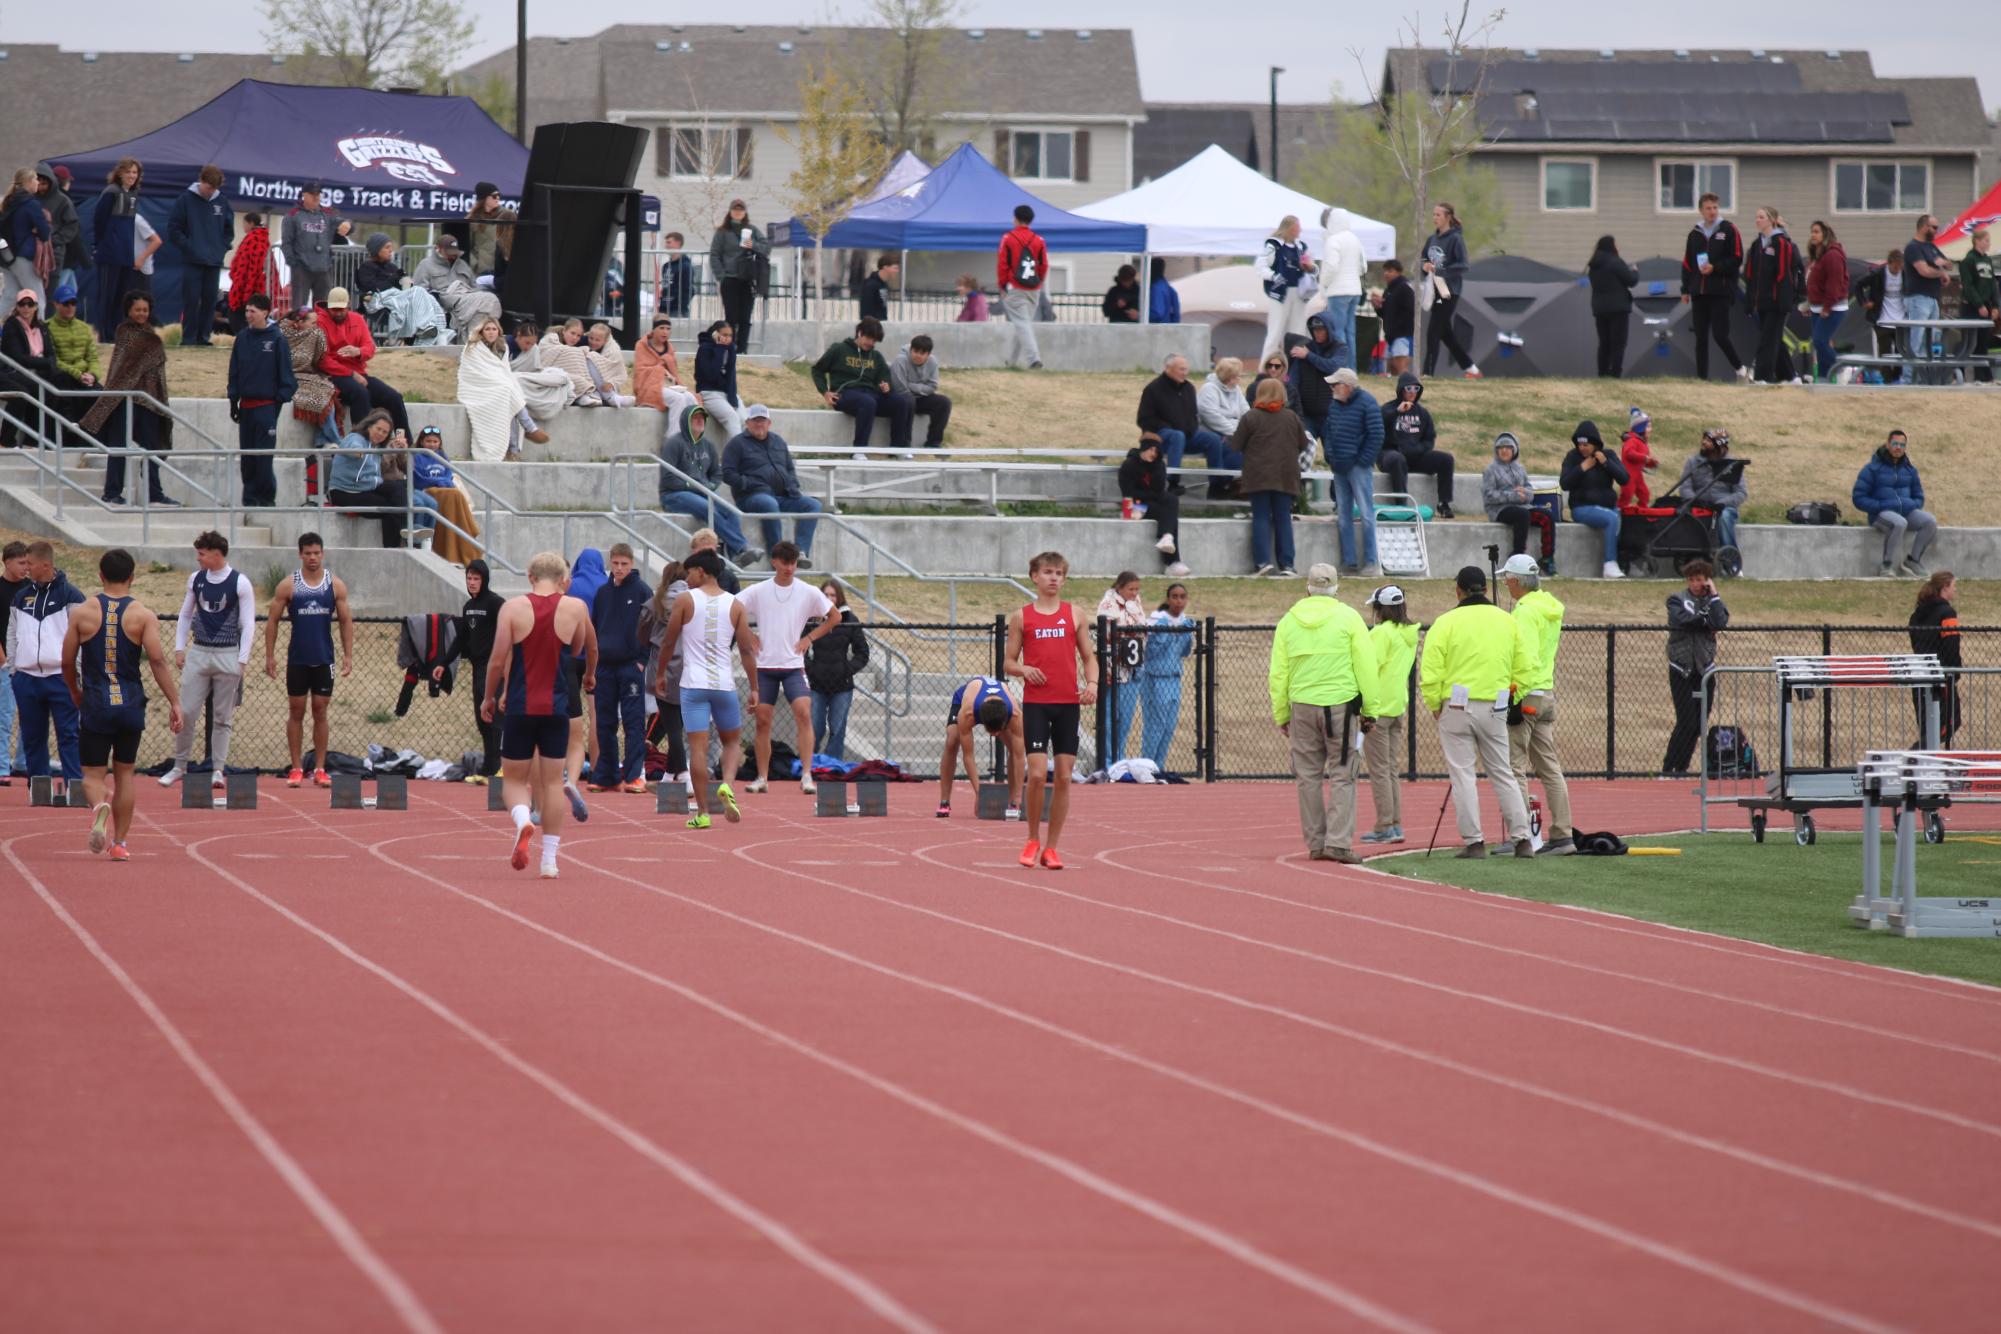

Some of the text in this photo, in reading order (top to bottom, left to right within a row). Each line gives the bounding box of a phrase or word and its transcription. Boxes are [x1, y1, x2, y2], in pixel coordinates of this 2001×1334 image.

[239, 176, 345, 207] Northrge
[350, 186, 404, 208] Track
[410, 189, 424, 210] &
[430, 190, 477, 213] Field
[1035, 627, 1065, 640] EATON
[1127, 639, 1139, 666] 3
[1958, 899, 1989, 908] UCS
